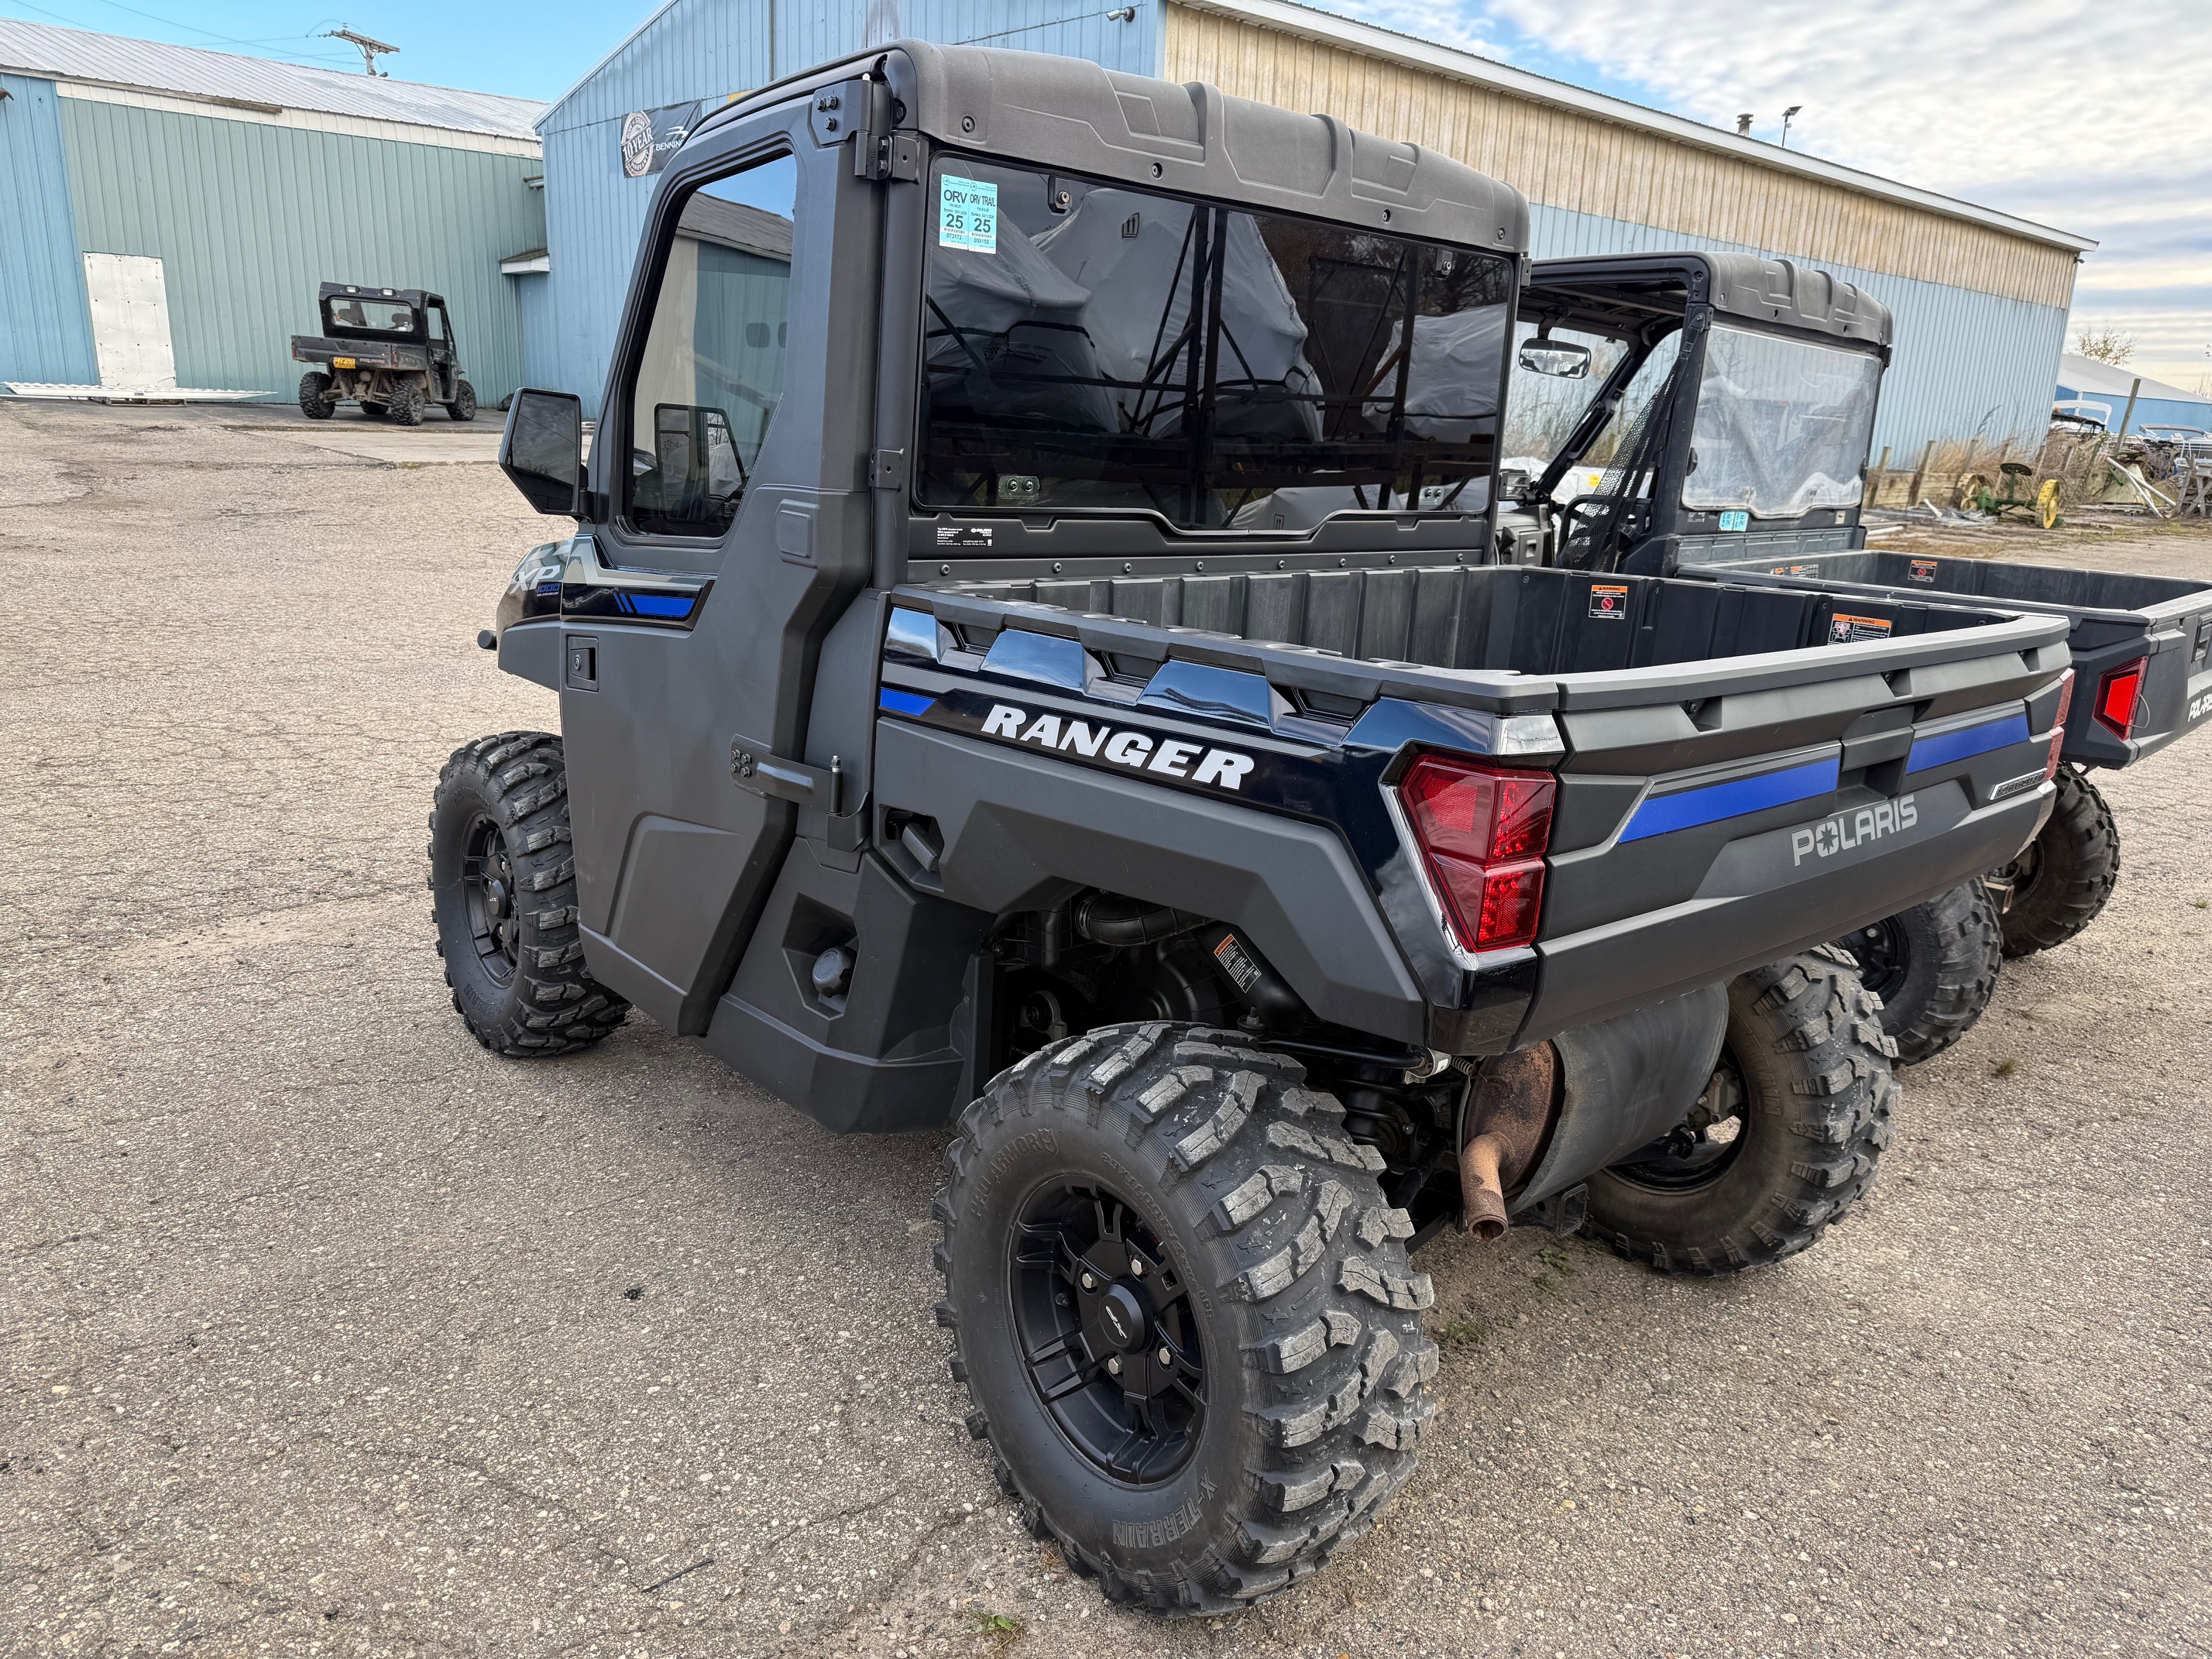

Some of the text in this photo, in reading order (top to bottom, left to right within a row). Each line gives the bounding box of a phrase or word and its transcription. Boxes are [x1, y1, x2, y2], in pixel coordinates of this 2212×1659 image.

[623, 127, 654, 163] 10 YEAR
[943, 189, 968, 204] ORV
[970, 194, 996, 207] ORV TRAIL
[946, 213, 963, 229] 25
[974, 218, 991, 233] 25
[509, 565, 561, 595] XP
[537, 583, 561, 593] 1000
[981, 704, 1255, 790] RANGER
[1791, 794, 1918, 866] POLARIS
[968, 1134, 1042, 1221] PRO ARMOR
